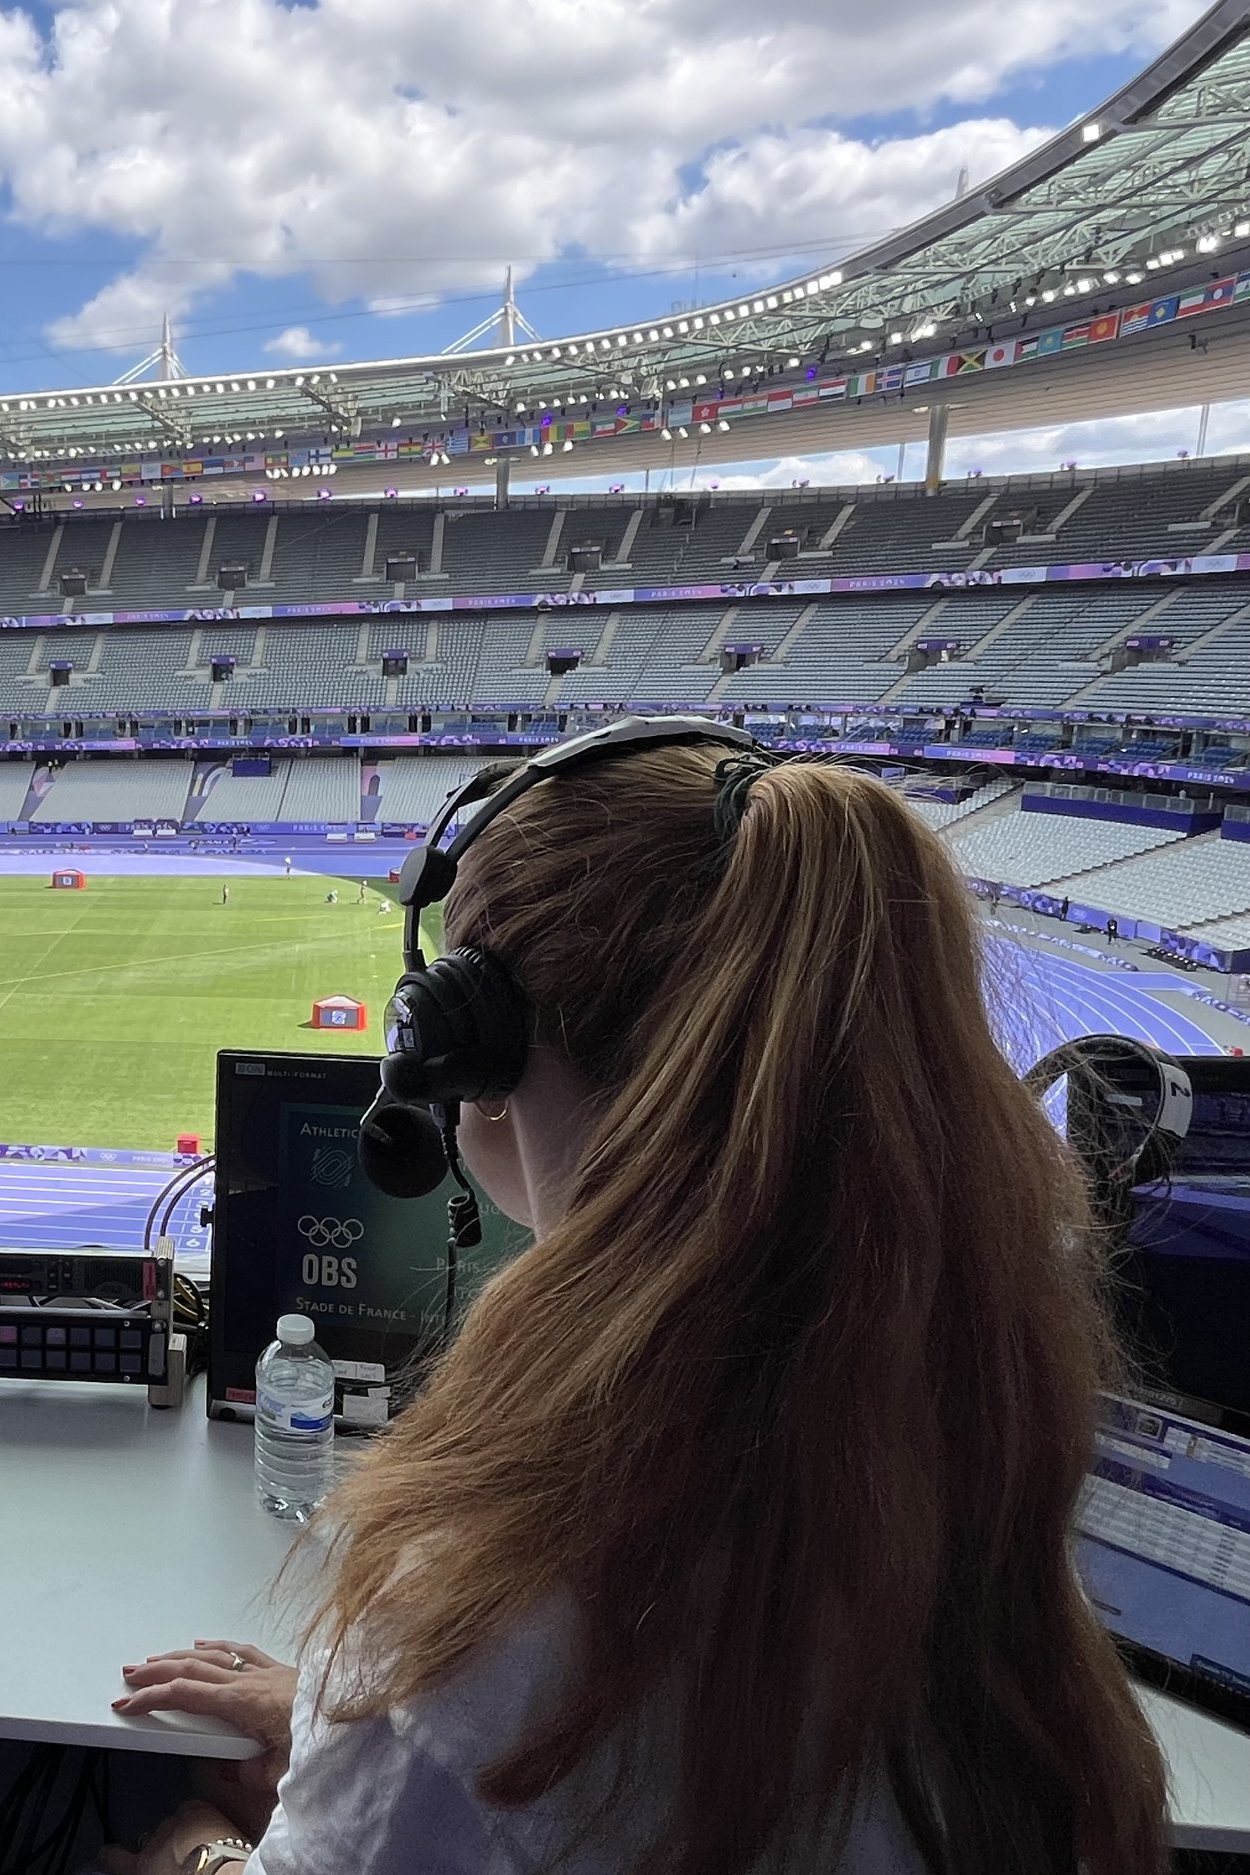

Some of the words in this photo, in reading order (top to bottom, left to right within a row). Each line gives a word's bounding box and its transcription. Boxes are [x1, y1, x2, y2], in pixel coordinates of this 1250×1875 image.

[850, 579, 876, 588] PARIS
[946, 750, 968, 758] PARIS
[1187, 771, 1211, 780] PARIS
[1213, 774, 1236, 784] 2024
[238, 1063, 263, 1075] BON
[267, 1070, 328, 1080] MULTI-FORMAT
[300, 1122, 360, 1139] ATHLETIC
[199, 1189, 212, 1197] 2
[186, 1238, 200, 1248] 6
[302, 1253, 358, 1289] OBS
[437, 1257, 480, 1274] PRIS
[295, 1297, 334, 1313] STADE
[339, 1304, 354, 1315] DE
[358, 1303, 406, 1320] FRANCE
